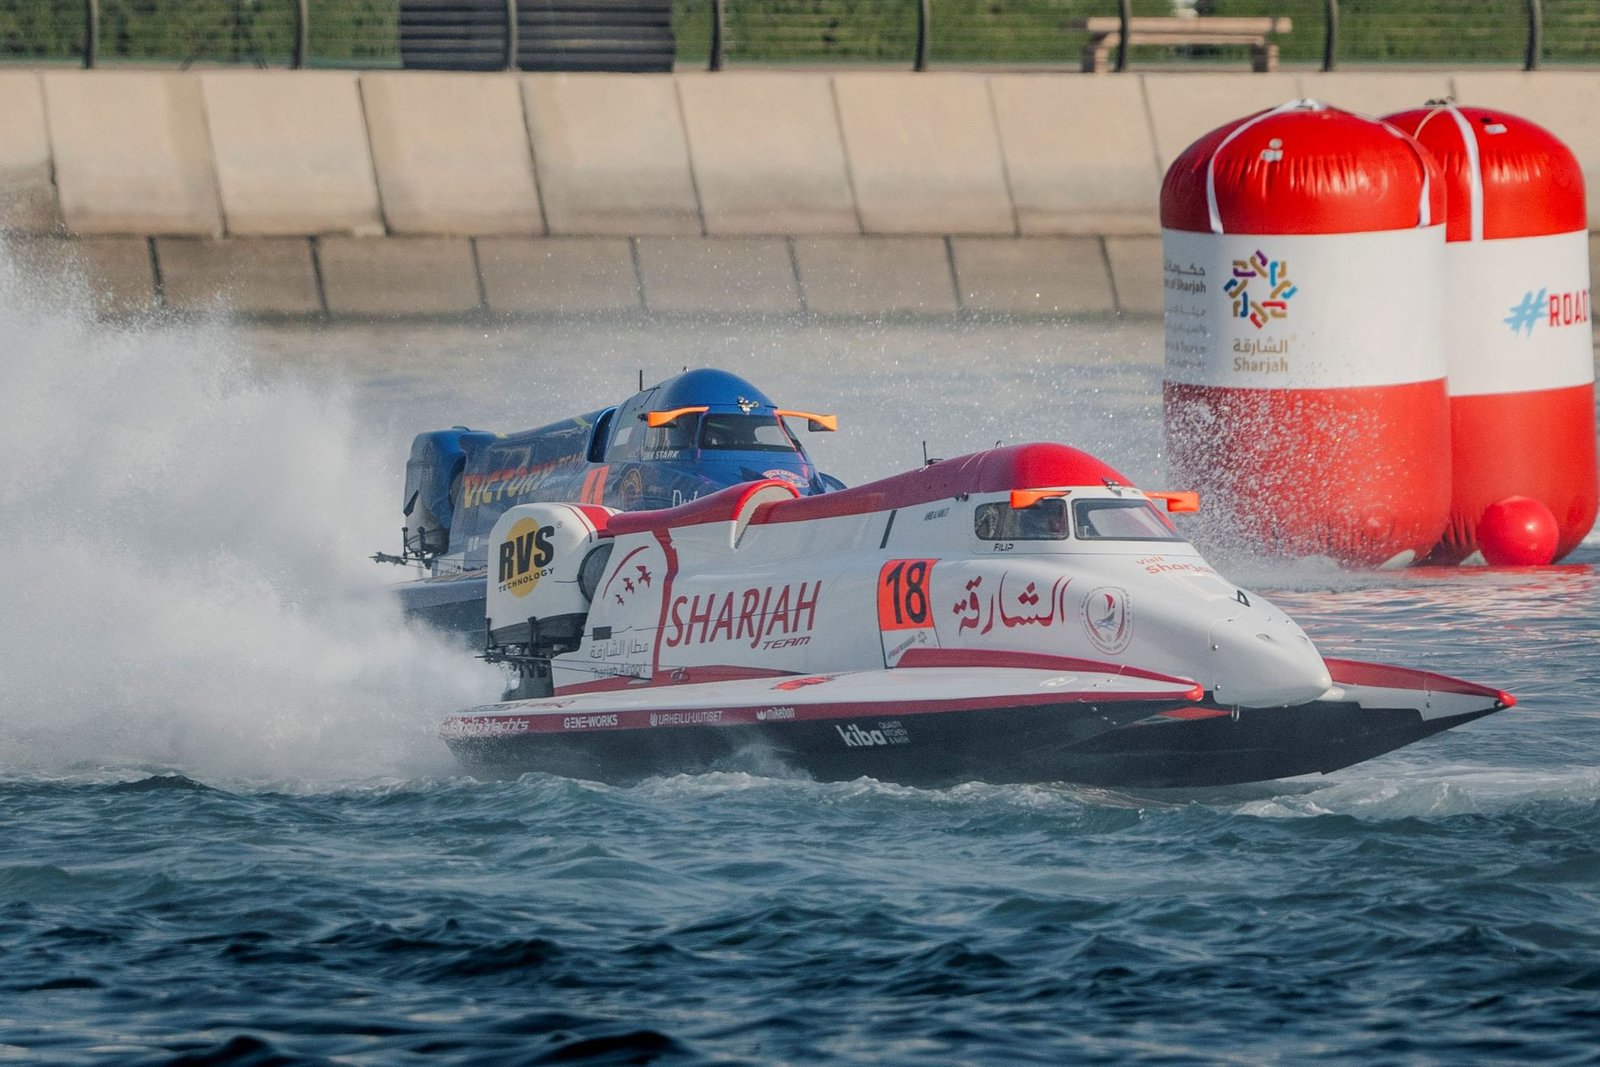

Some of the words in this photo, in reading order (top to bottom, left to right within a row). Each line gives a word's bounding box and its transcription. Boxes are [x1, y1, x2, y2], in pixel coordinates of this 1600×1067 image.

[1233, 336, 1288, 356] الشارقة
[1233, 357, 1288, 374] Sharjah
[499, 525, 555, 583] RVS
[993, 543, 1014, 552] FILIP
[498, 567, 554, 593] TECHNOLOGY
[886, 561, 928, 624] 18
[953, 570, 1073, 637] الشارقة
[666, 580, 822, 649] SHARJAH
[763, 636, 811, 650] TEAM
[563, 714, 618, 729] GENE-WORKS
[835, 723, 888, 747] kiba
